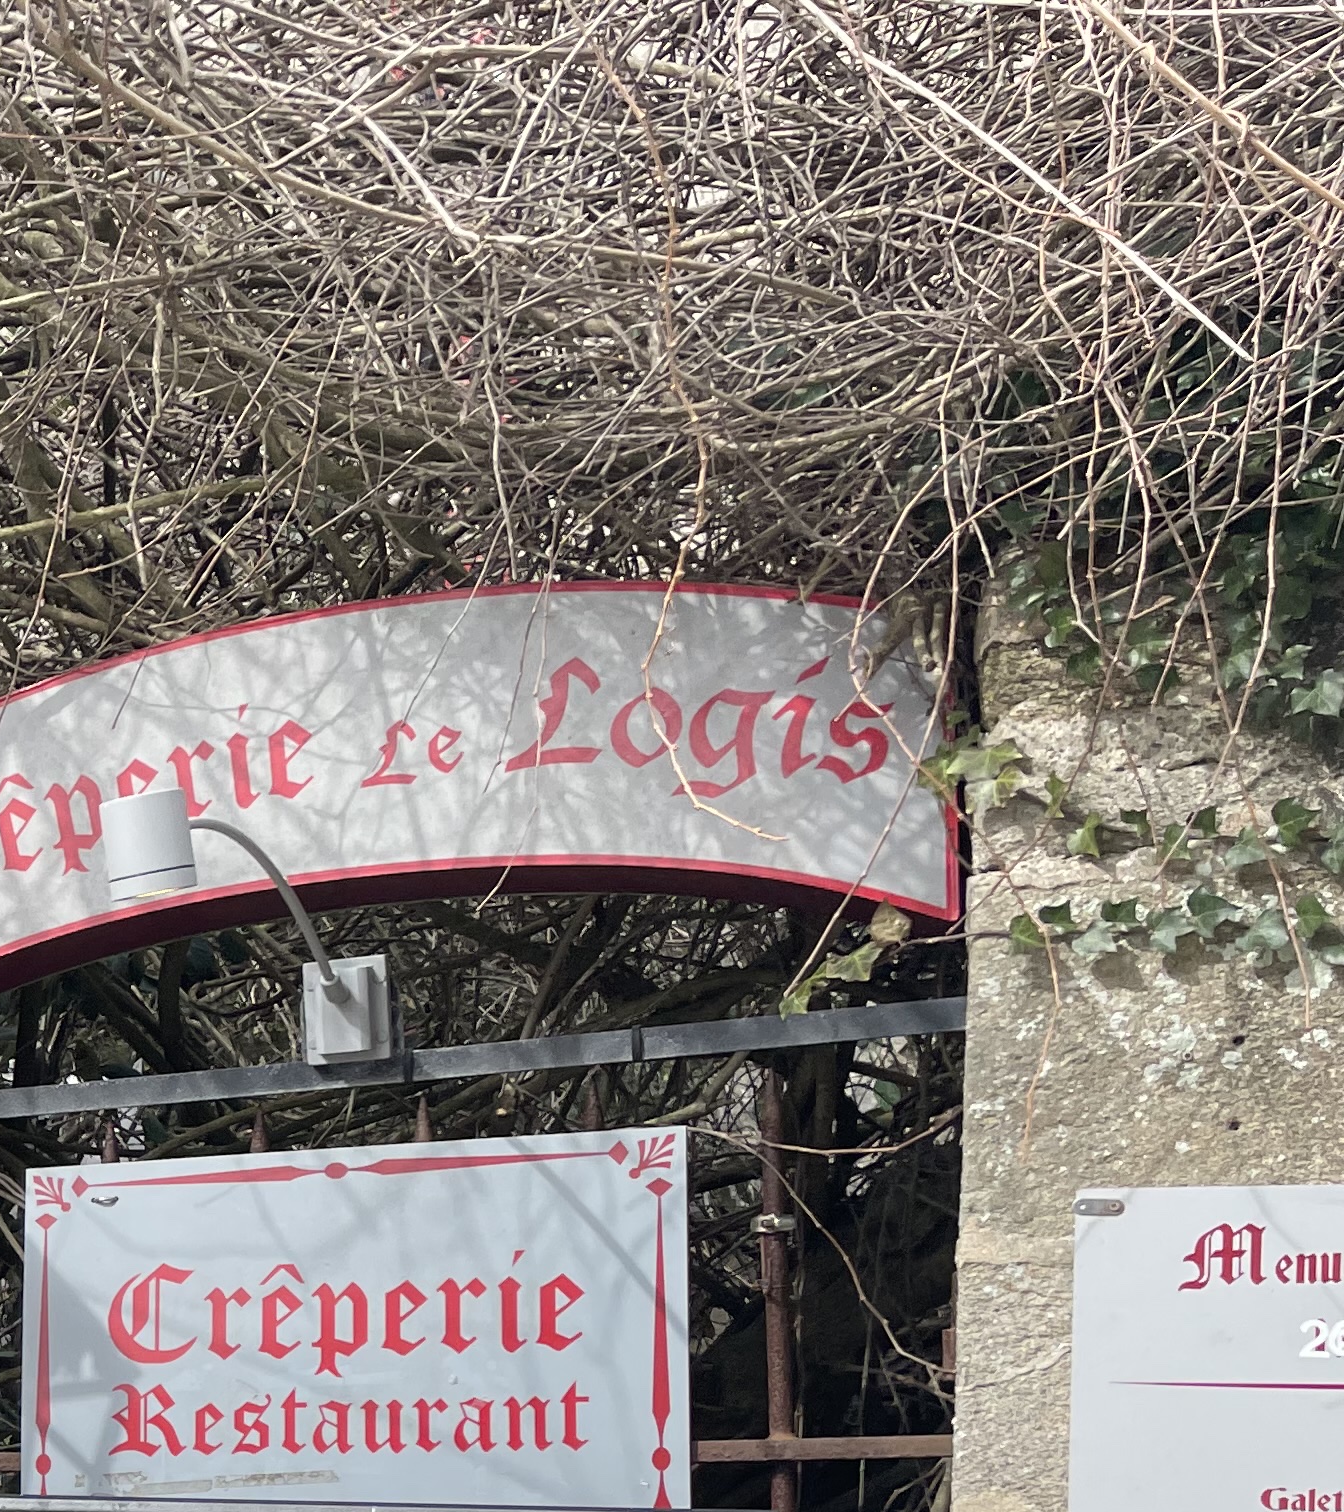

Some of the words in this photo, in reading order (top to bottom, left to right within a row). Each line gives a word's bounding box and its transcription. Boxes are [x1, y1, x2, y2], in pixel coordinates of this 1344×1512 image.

[360, 719, 463, 789] Le
[504, 655, 895, 799] Logis
[1178, 1223, 1342, 1291] Menu
[107, 1249, 586, 1378] Crêperie
[108, 1380, 590, 1457] Restaurant
